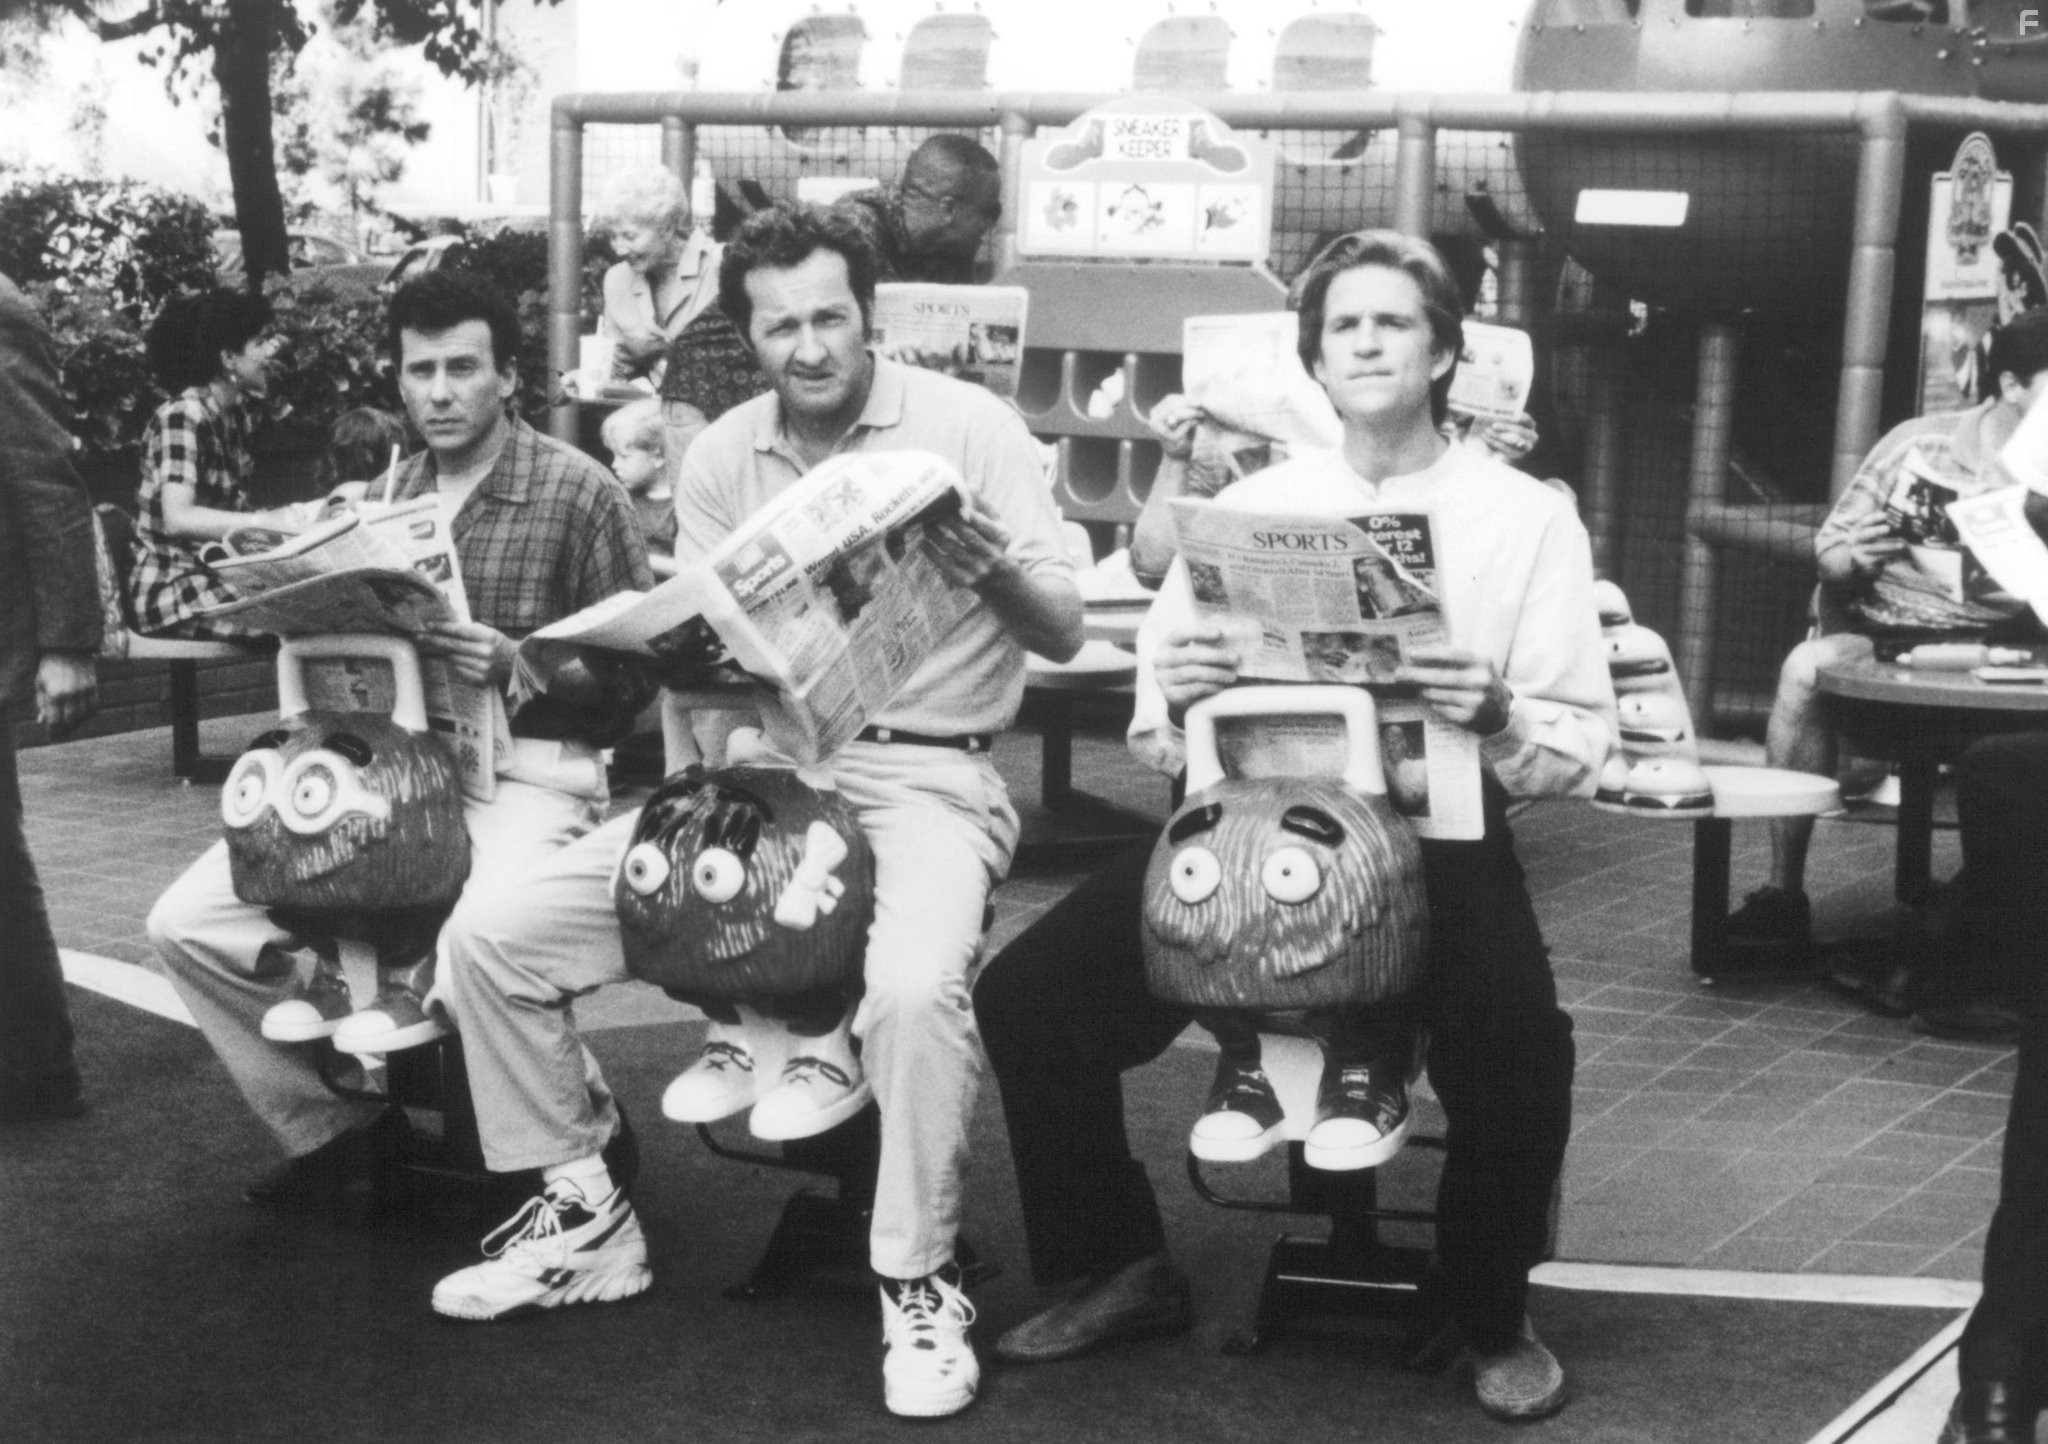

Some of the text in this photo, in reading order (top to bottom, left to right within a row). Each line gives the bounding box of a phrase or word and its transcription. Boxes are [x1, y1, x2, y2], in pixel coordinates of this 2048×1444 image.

[1113, 119, 1181, 136] SNEAKER
[1118, 140, 1173, 158] KEEPER
[913, 302, 970, 316] SPORTS
[1368, 515, 1402, 529] 0%
[1252, 531, 1349, 551] SPORTS
[1396, 540, 1414, 552] 12
[734, 554, 786, 598] Sports
